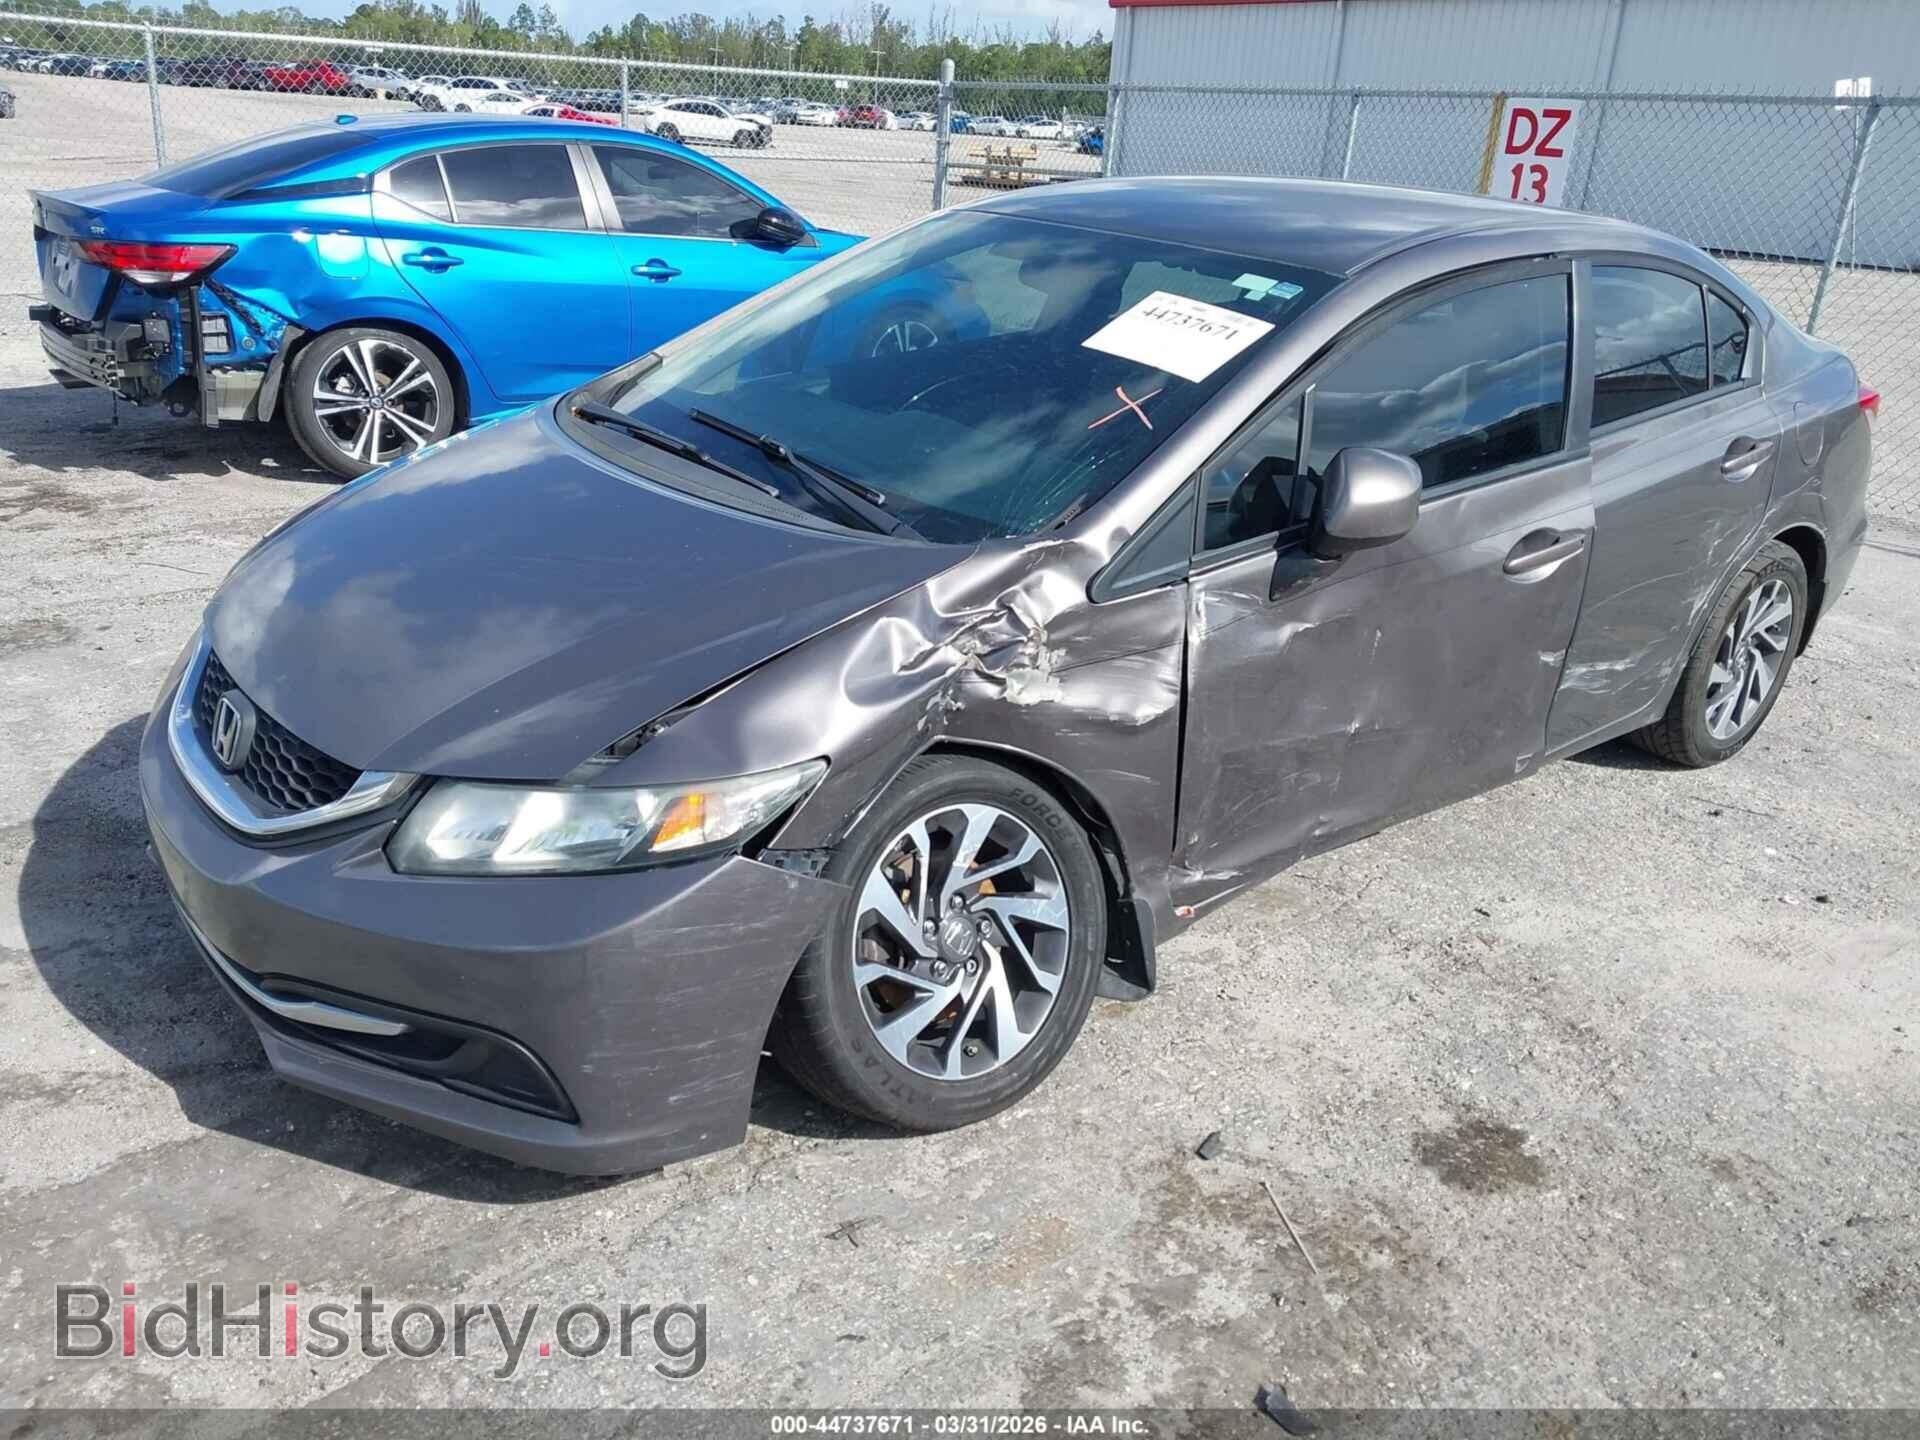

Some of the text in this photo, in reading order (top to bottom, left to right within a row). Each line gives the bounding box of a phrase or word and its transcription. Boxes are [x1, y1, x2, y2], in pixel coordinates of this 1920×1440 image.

[1504, 107, 1572, 158] DZ
[1511, 162, 1549, 204] 13
[1141, 305, 1240, 341] 44737671
